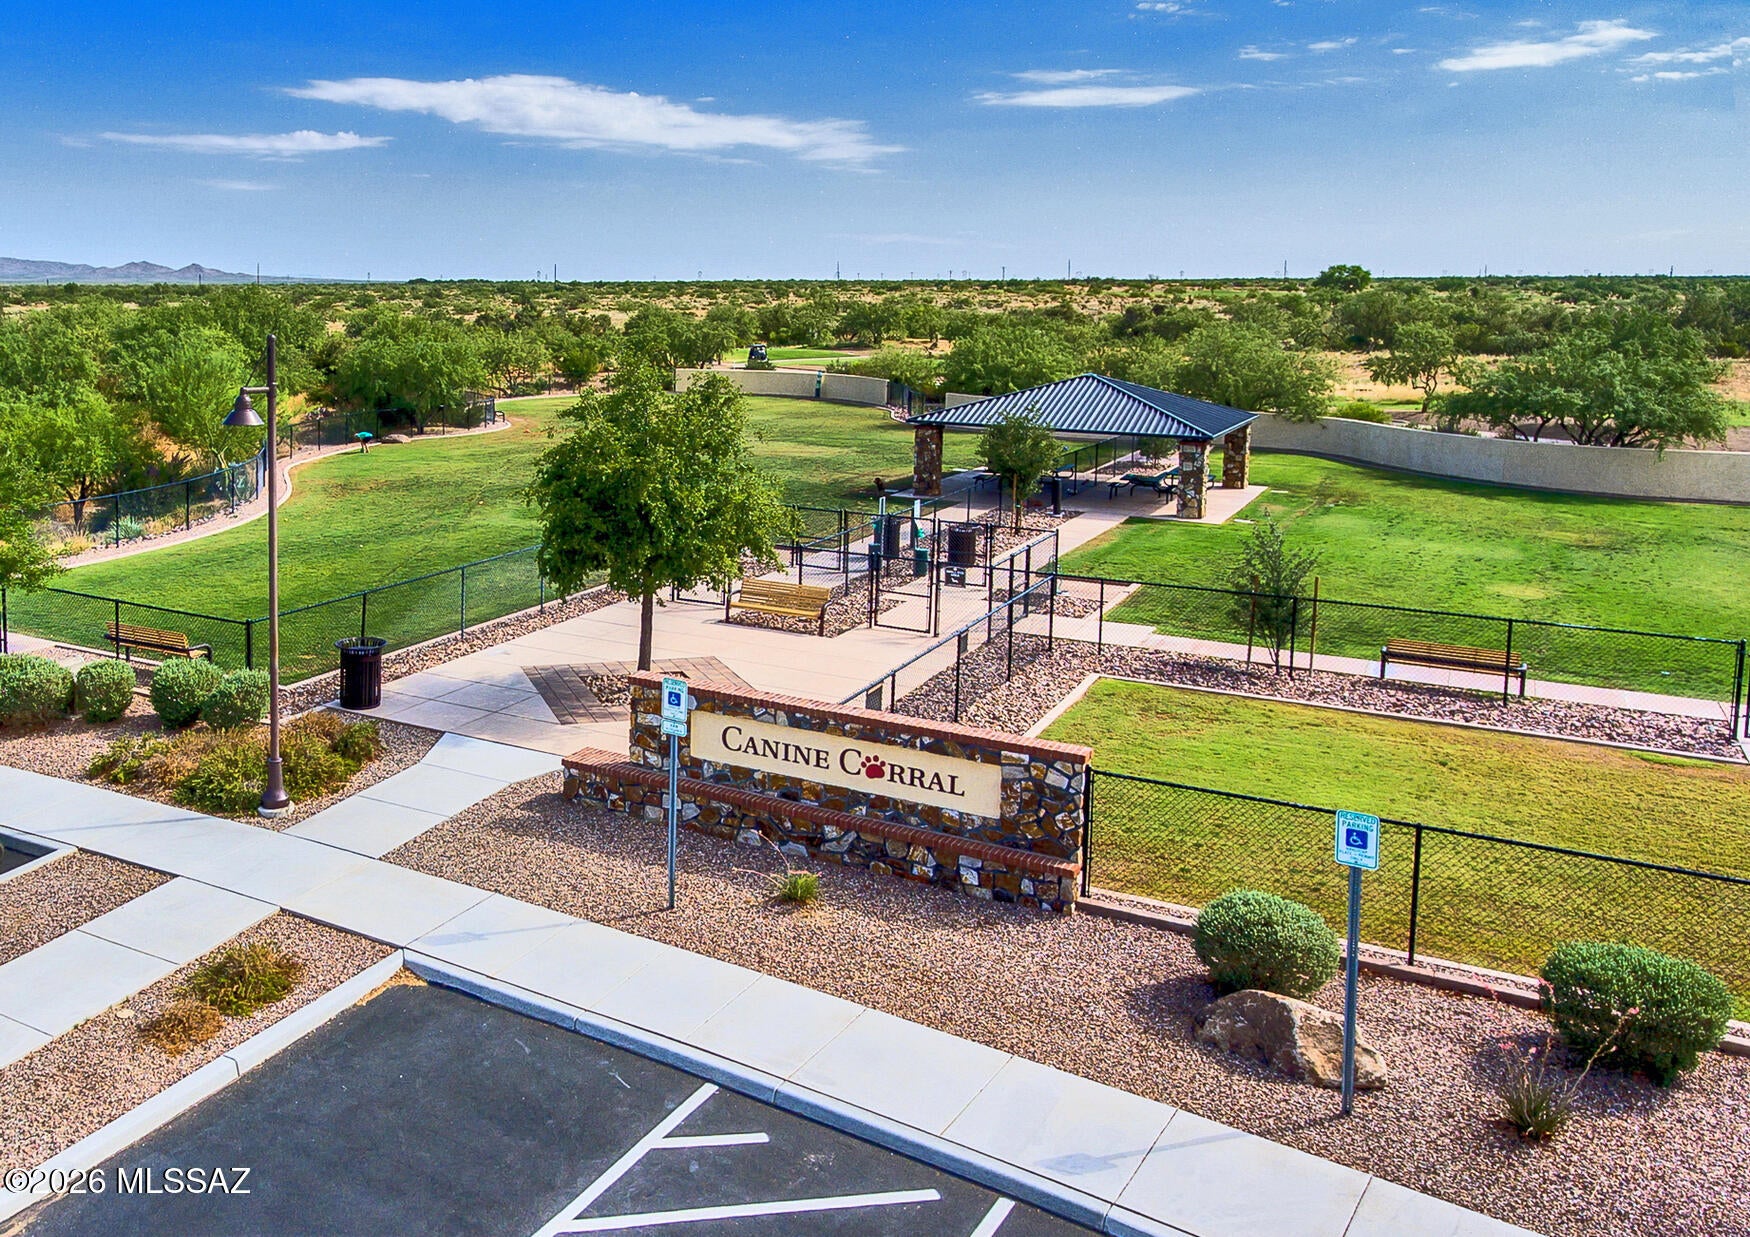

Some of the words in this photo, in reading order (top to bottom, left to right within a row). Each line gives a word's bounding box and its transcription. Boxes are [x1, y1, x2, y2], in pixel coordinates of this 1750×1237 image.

[721, 725, 830, 770] CANINE
[839, 748, 966, 797] CRRAL
[1342, 820, 1374, 832] PARKING
